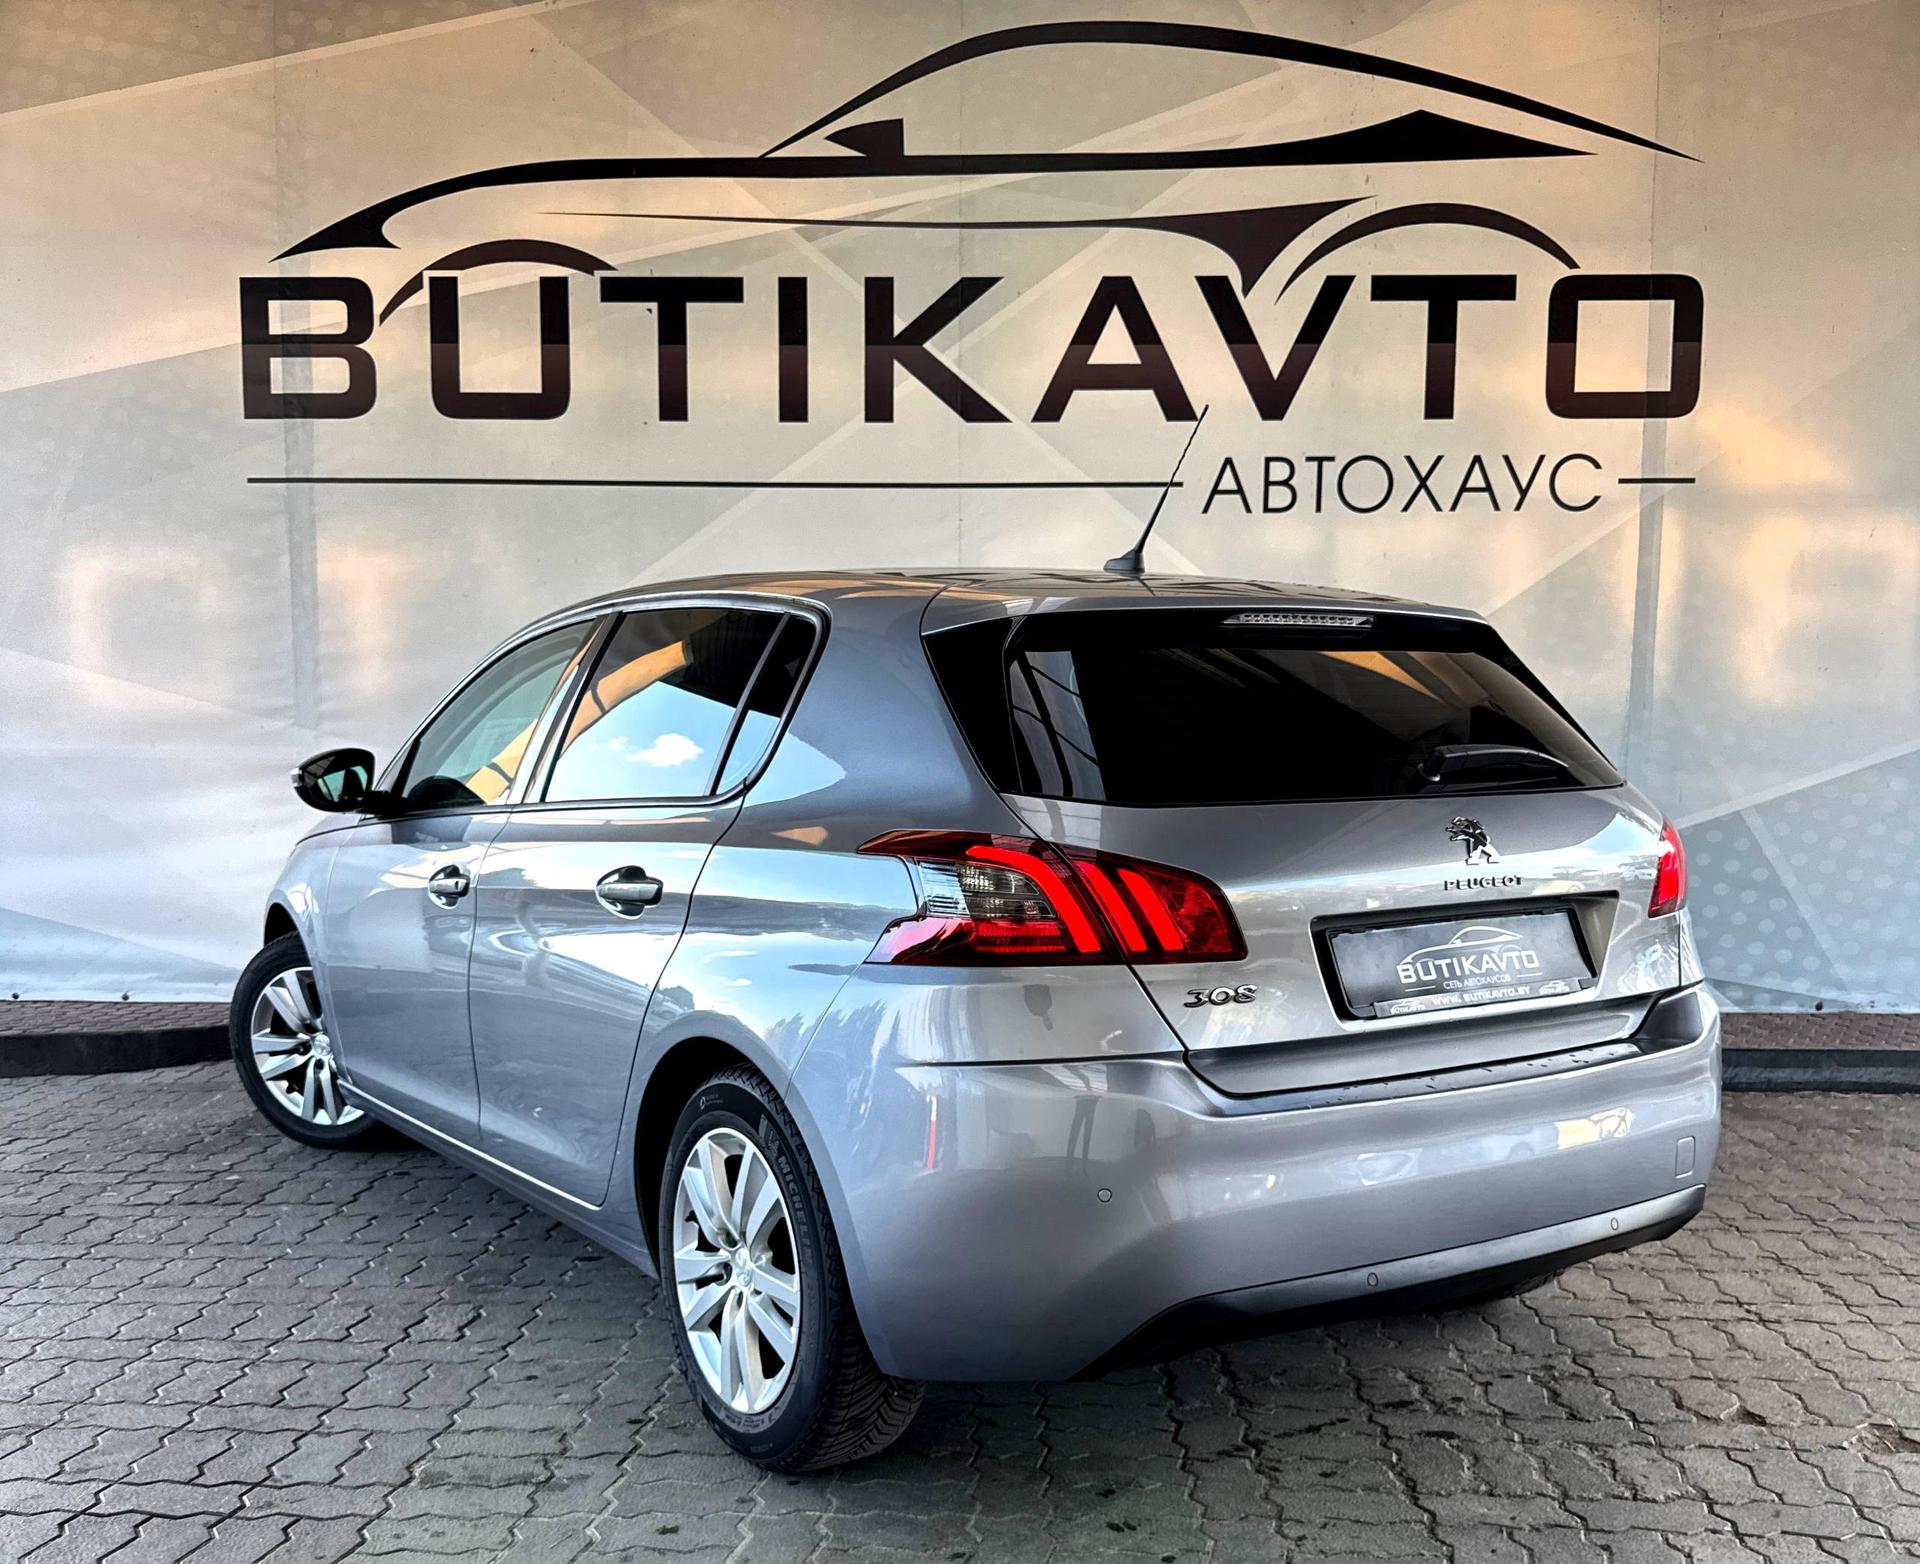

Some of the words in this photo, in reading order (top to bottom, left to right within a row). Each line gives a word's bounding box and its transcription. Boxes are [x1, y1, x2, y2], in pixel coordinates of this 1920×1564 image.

[240, 274, 1704, 423] BUTIKAVTO
[1202, 453, 1603, 514] АВТОХАУС
[1444, 874, 1522, 891] PEUGEOT
[1396, 950, 1540, 984] BUTIKAVTO
[1183, 983, 1258, 1008] 308
